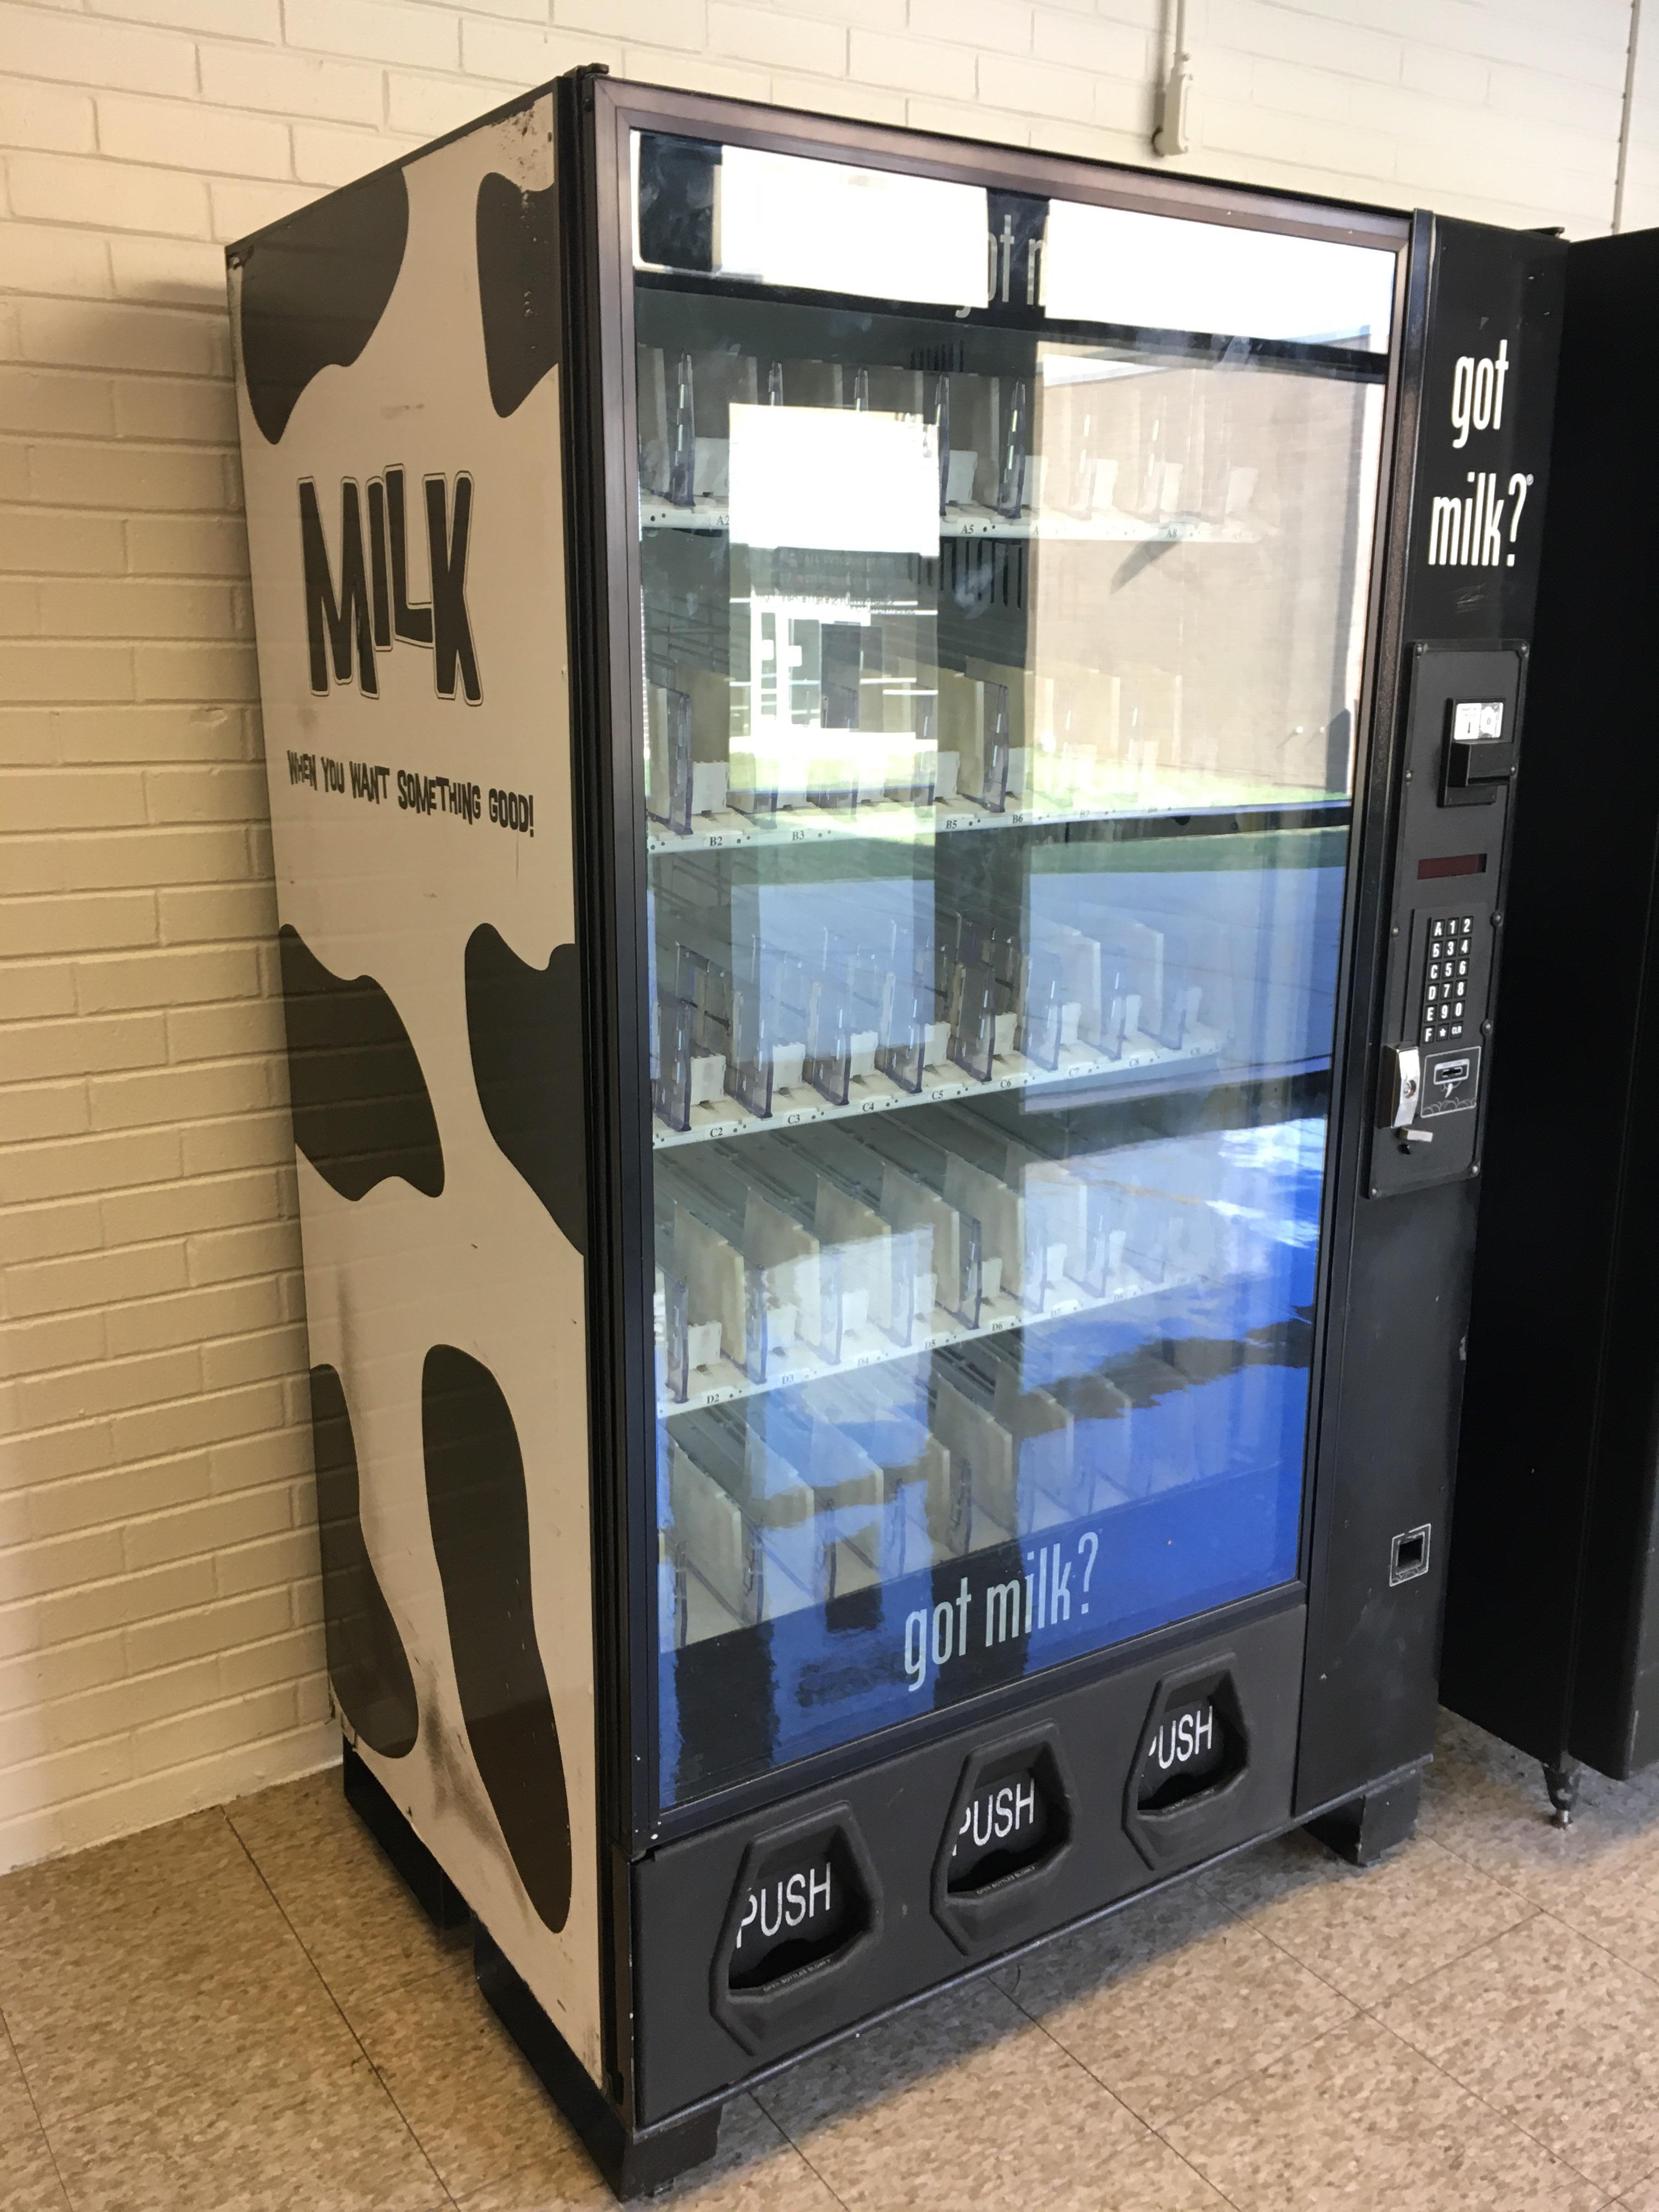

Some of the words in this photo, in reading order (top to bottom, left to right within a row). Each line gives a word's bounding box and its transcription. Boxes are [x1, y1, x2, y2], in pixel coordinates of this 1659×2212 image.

[1451, 339, 1509, 449] got
[961, 523, 974, 534] A5
[1428, 472, 1527, 566] milk?
[297, 462, 483, 706] MILK
[287, 749, 318, 791] WHEN
[320, 756, 345, 794] YOU
[349, 760, 390, 805] WANT
[397, 769, 481, 826] SOMETHING
[488, 789, 534, 838] GOOD!
[709, 836, 724, 847] B2
[792, 831, 805, 841] B3
[945, 819, 958, 830] B5
[1012, 814, 1024, 824] B6
[1434, 922, 1442, 936] A
[1450, 920, 1455, 934] 1
[1463, 918, 1470, 932] 2
[1447, 941, 1454, 956] 3
[1462, 939, 1468, 953] 4
[1429, 986, 1436, 1000] D
[1443, 984, 1450, 998] 7
[1457, 981, 1464, 996] 8
[1430, 964, 1438, 979] C
[1445, 962, 1452, 977] 5
[1459, 961, 1466, 975] 6
[1425, 1028, 1432, 1042] F
[1427, 1007, 1434, 1022] E
[1441, 1005, 1448, 1019] 9
[709, 1127, 724, 1138] C2
[787, 1113, 800, 1124] C3
[862, 1101, 875, 1113] C4
[932, 1090, 944, 1100] C5
[1000, 1078, 1012, 1088] C6
[1068, 1067, 1080, 1077] C7
[707, 1393, 720, 1404] D2
[782, 1374, 794, 1385] D3
[857, 1356, 870, 1366] D4
[992, 1321, 1003, 1331] D6
[905, 1577, 972, 1691] got
[986, 1532, 1098, 1646] milk?
[1148, 1705, 1213, 1769] USH
